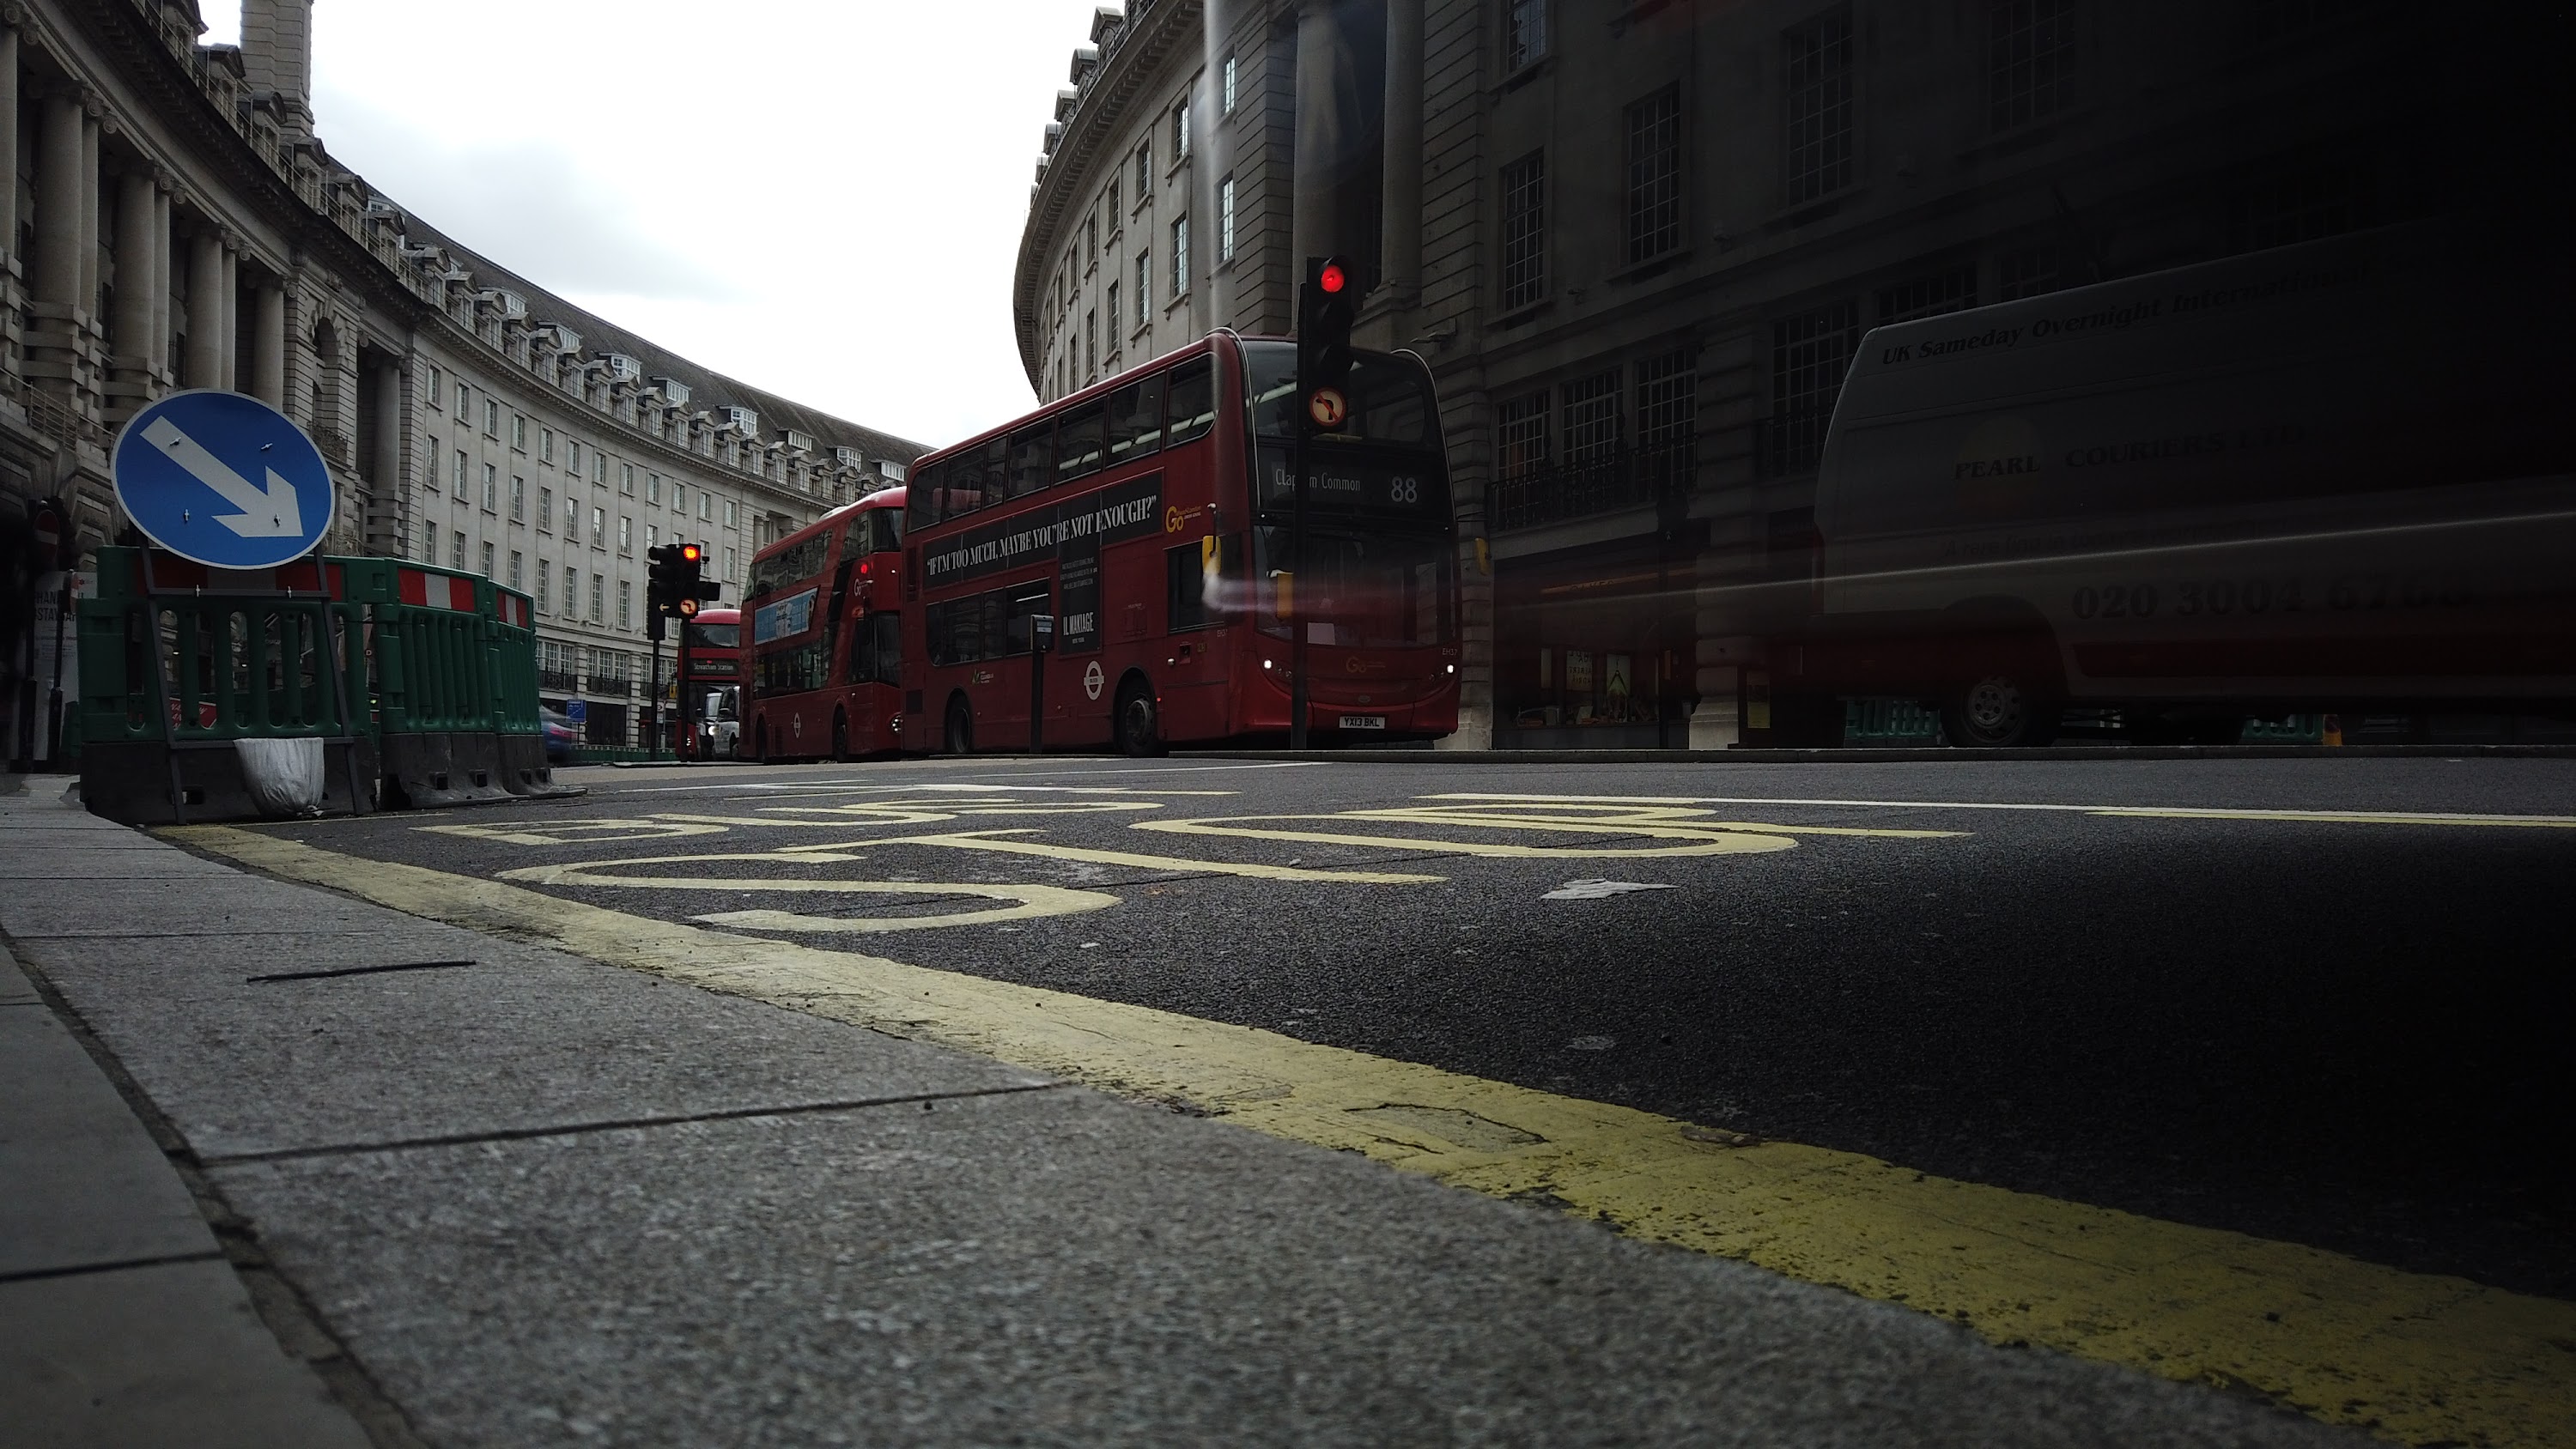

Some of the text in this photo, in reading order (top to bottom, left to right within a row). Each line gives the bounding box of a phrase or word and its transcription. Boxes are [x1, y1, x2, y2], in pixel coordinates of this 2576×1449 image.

[1882, 345, 1911, 366] UK
[1917, 326, 2024, 359] Sameday
[2032, 297, 2162, 337] Overnight
[1953, 424, 2307, 480] PEARL COURIERS LTD
[1275, 468, 1361, 492] Clapm Common
[1390, 476, 1418, 504] 88
[951, 549, 969, 570] TOO
[969, 541, 999, 566] MUCH,
[999, 530, 1032, 558] MAYBE
[1032, 519, 1070, 549] YOU'RE
[1070, 512, 1094, 540] NOT
[1165, 506, 1184, 533] Go
[2071, 583, 2160, 621] 020
[2176, 577, 2306, 619] 3004
[1344, 717, 1380, 727] YX13 BKL
[410, 798, 1165, 846] BUS
[494, 803, 1975, 932] STOP
